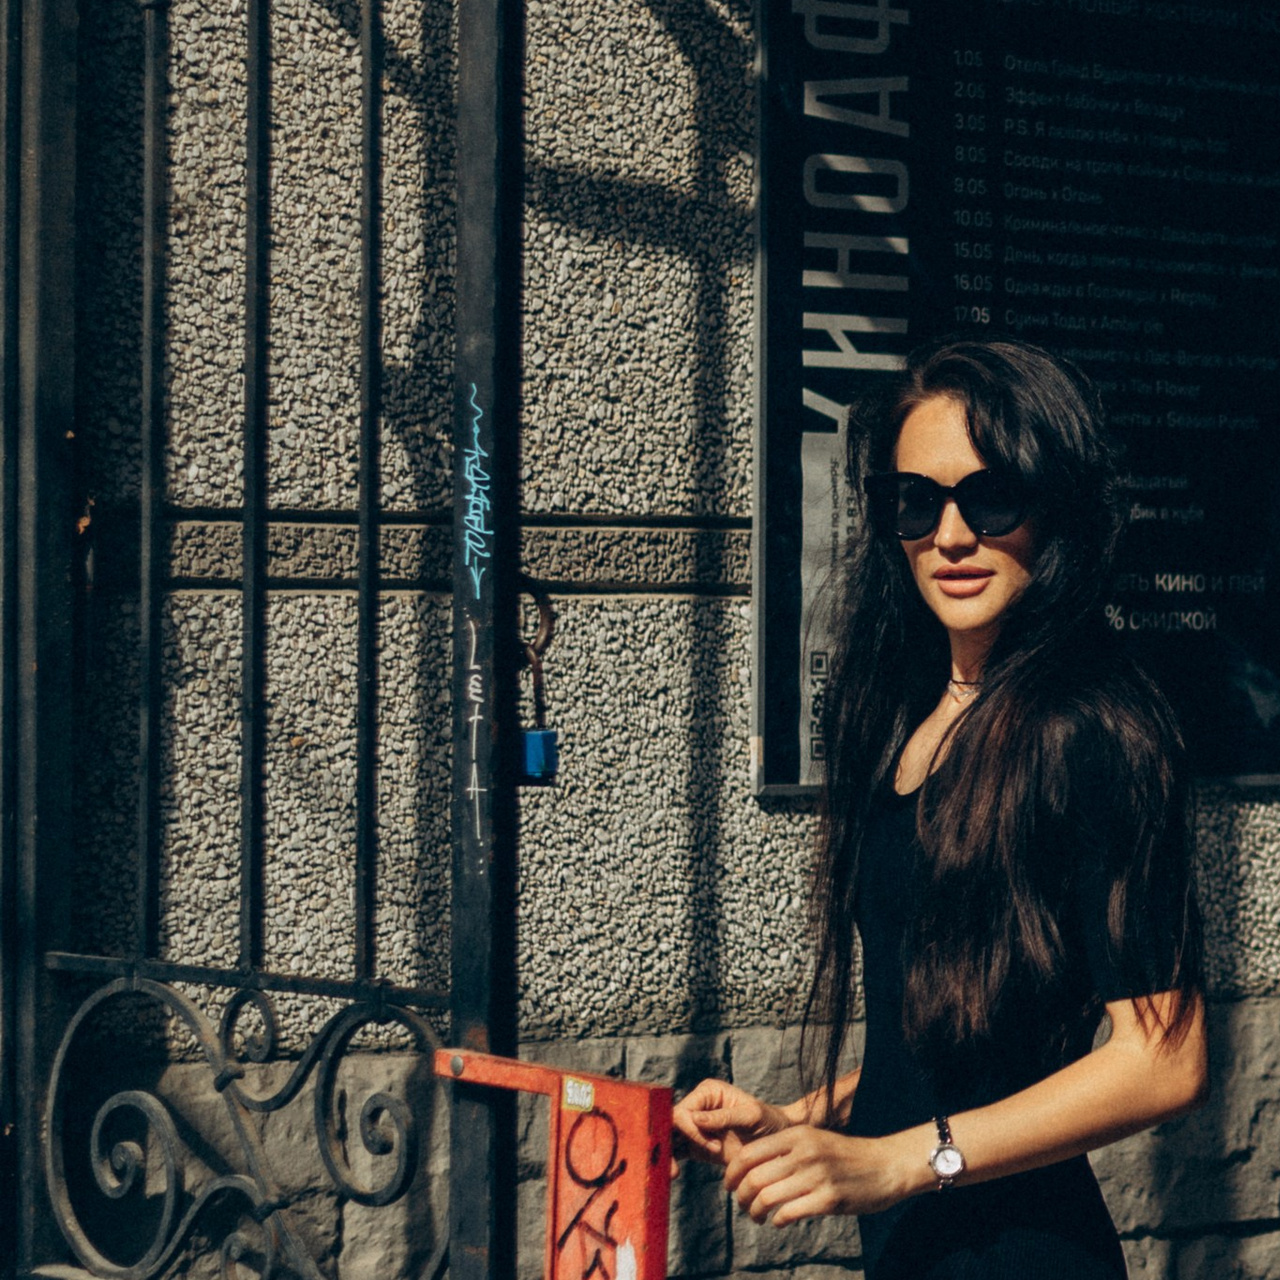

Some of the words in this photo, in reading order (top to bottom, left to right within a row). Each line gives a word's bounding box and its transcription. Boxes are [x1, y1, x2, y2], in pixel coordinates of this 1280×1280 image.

[955, 81, 986, 100] 2.05
[955, 113, 986, 132] 3.05
[955, 145, 987, 164] 8.05
[954, 177, 988, 196] 9.05
[1003, 181, 1048, 201] Огонь
[954, 209, 993, 228] 10.05
[954, 241, 993, 261] 15.05
[954, 274, 993, 293] 16.05
[954, 306, 991, 326] 17.05
[1154, 573, 1206, 593] КИНО
[1211, 575, 1223, 592] и
[1129, 605, 1217, 632] скидкой
